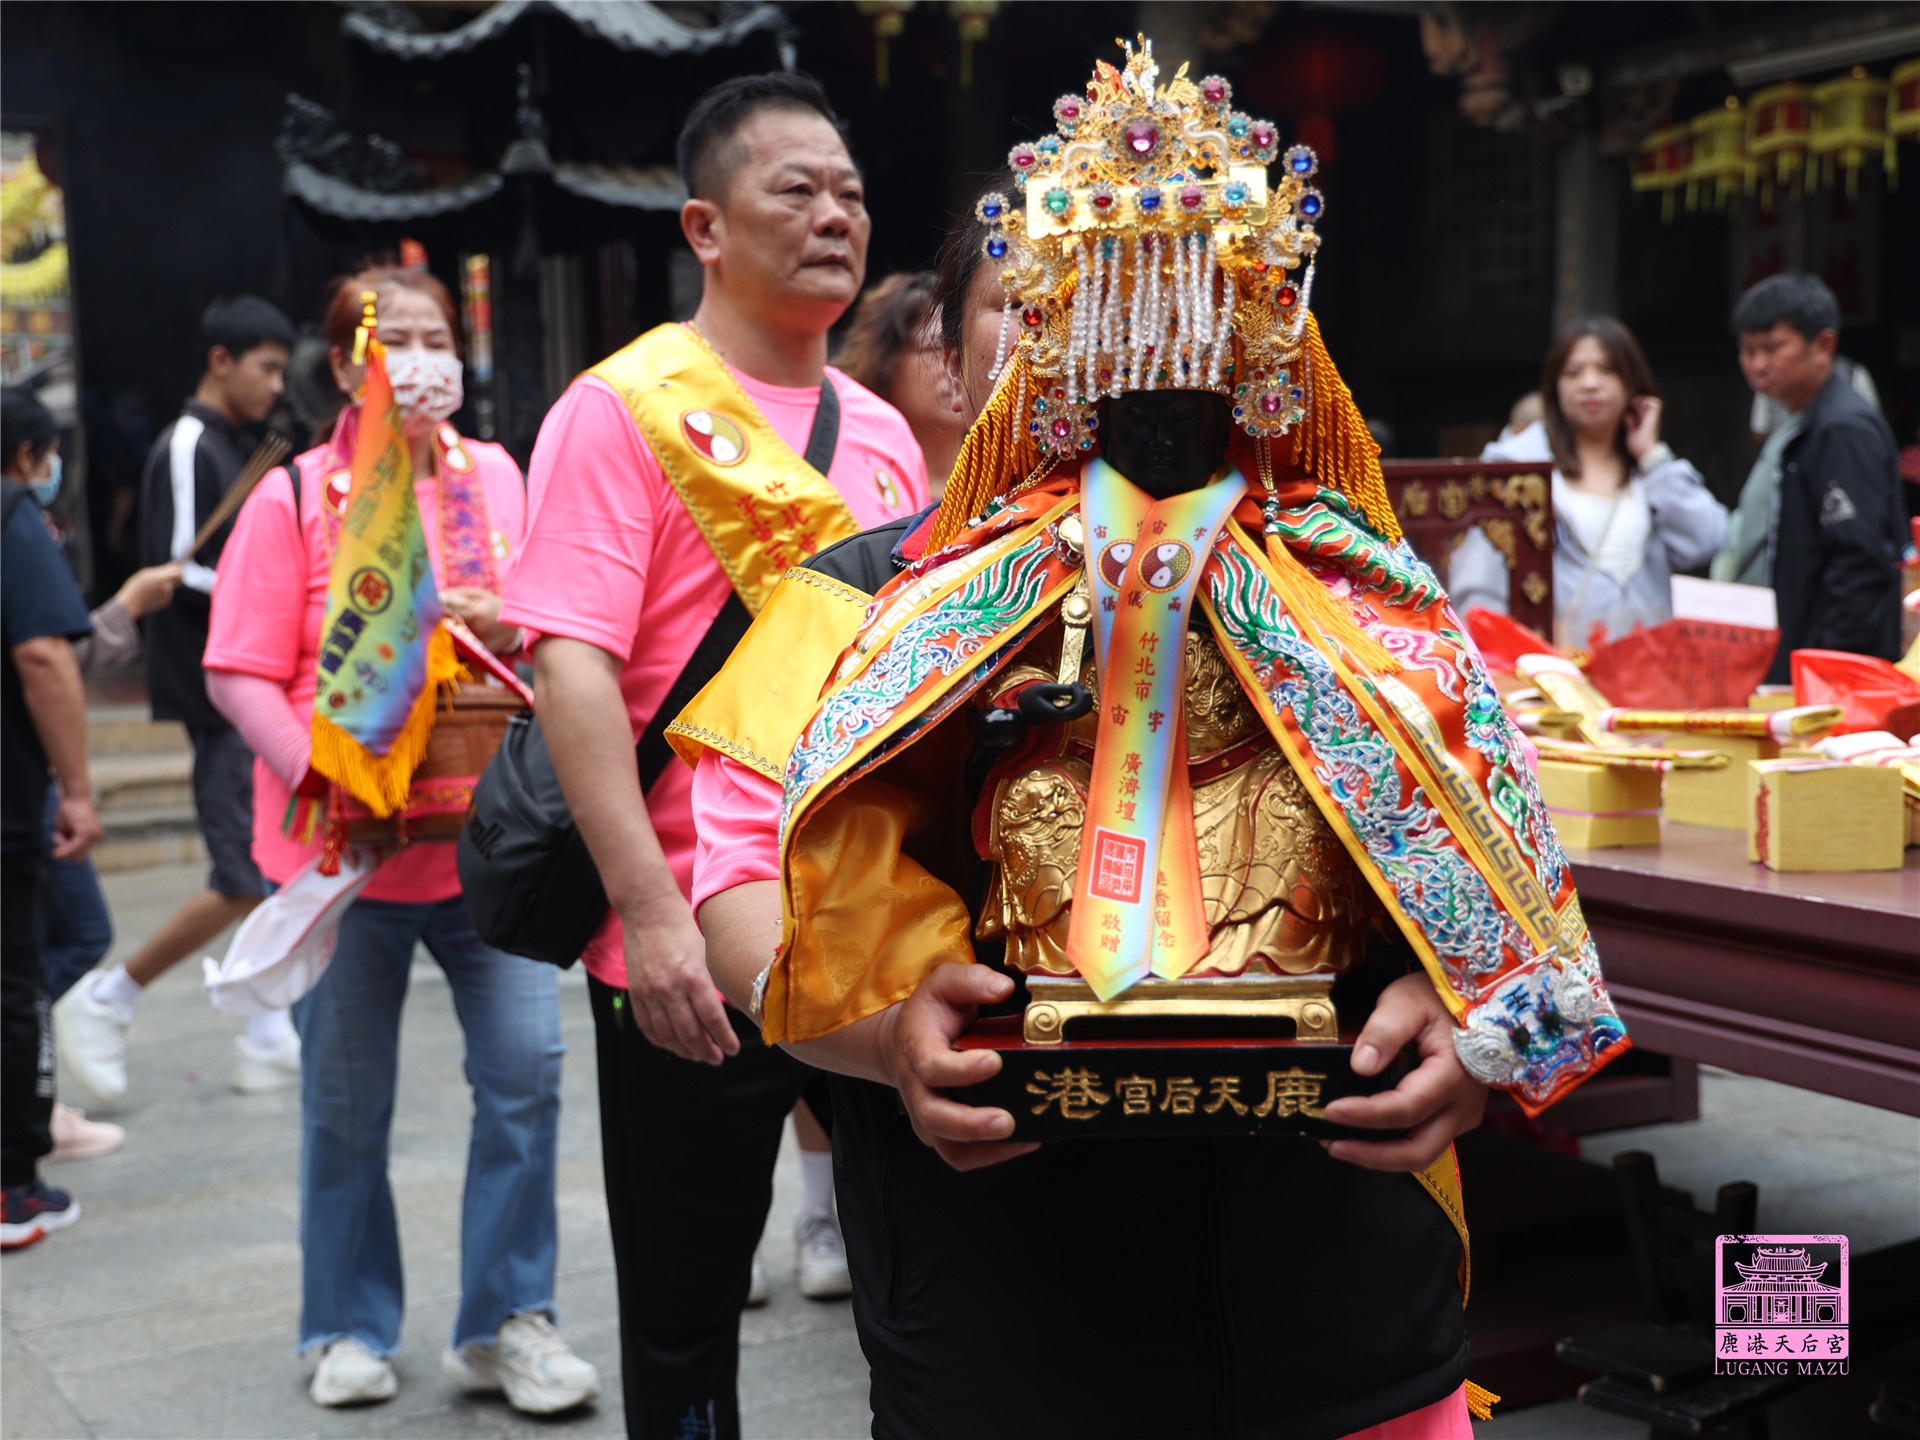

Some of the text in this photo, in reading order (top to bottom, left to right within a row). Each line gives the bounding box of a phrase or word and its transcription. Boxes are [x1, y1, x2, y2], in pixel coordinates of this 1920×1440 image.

[1134, 632, 1160, 702] 竹北市
[1115, 752, 1143, 822] 廣濟壇
[1099, 913, 1122, 953] 敬贈
